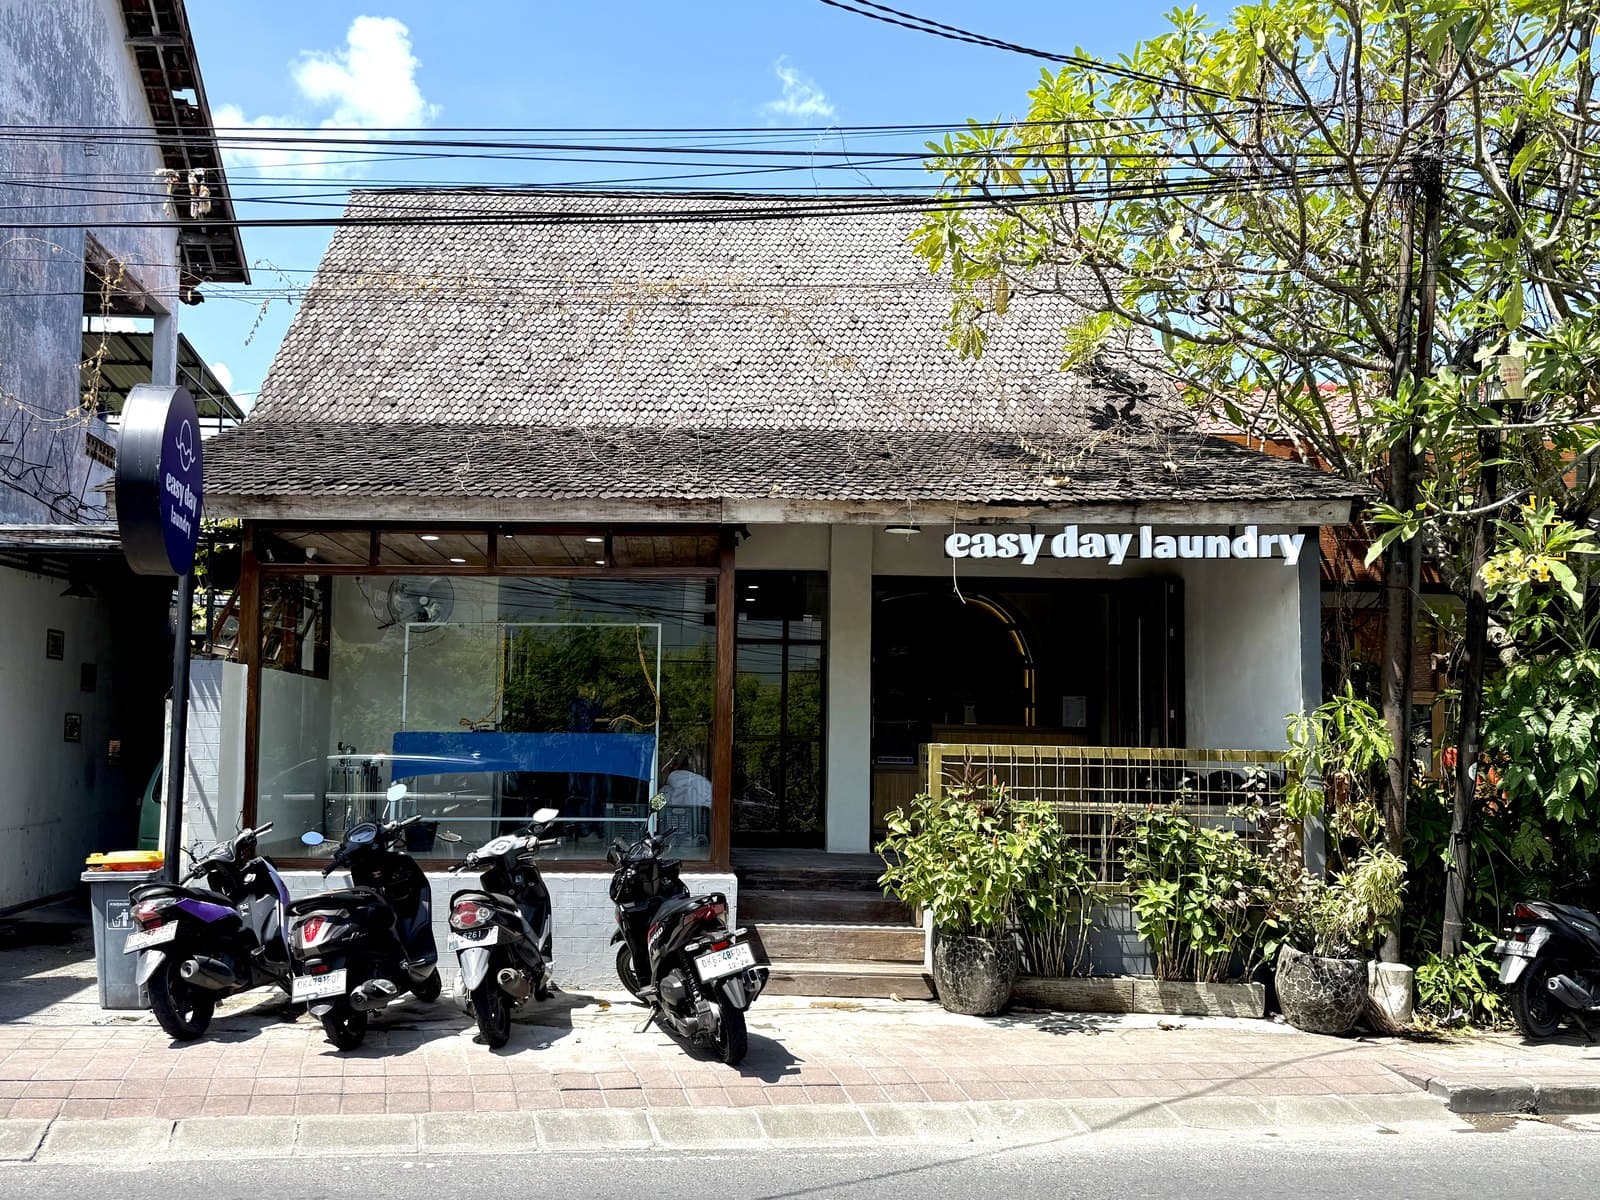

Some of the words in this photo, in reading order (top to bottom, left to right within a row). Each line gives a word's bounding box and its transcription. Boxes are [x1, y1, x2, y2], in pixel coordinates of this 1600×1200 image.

[166, 473, 185, 507] easy
[184, 483, 197, 518] day
[170, 504, 192, 540] laundry
[944, 532, 1045, 565] easy
[1050, 524, 1133, 565] day
[1139, 525, 1305, 565] laundry
